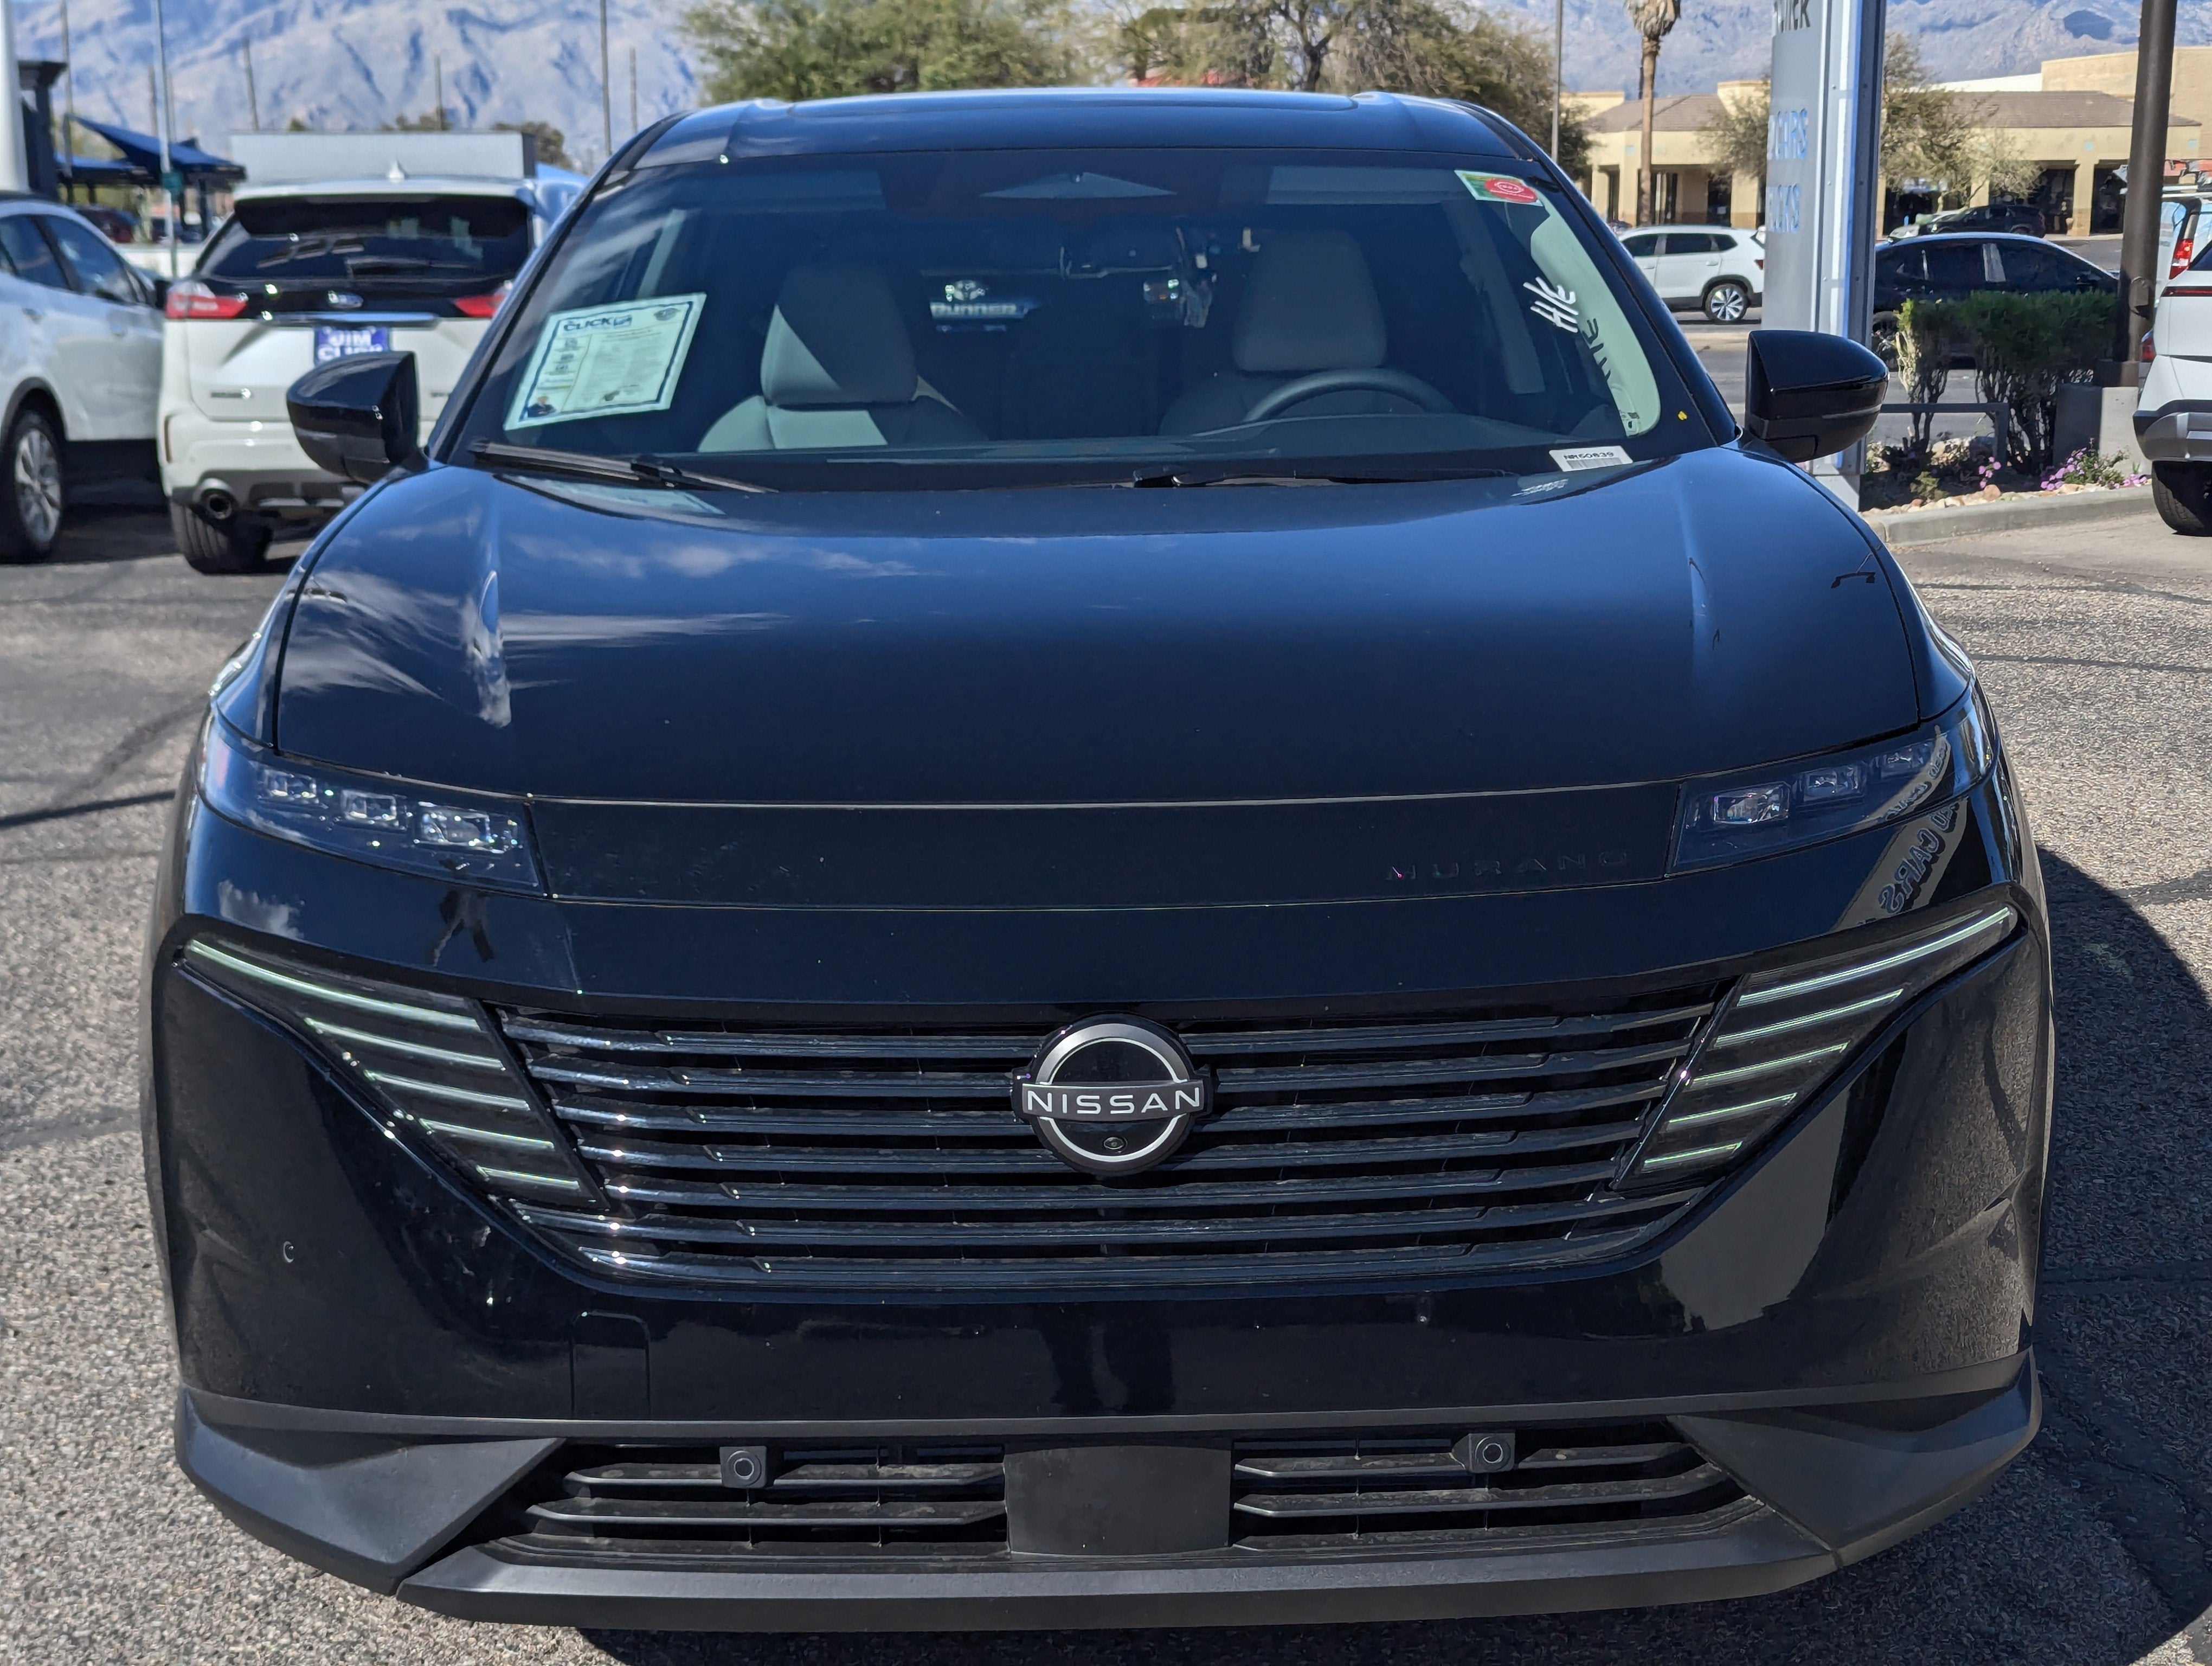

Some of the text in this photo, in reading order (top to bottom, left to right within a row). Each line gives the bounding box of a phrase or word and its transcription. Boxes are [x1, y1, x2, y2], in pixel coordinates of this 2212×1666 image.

[328, 330, 371, 346] JIM
[1386, 850, 1627, 880] MURANO
[1027, 1087, 1200, 1114] NISSAN
